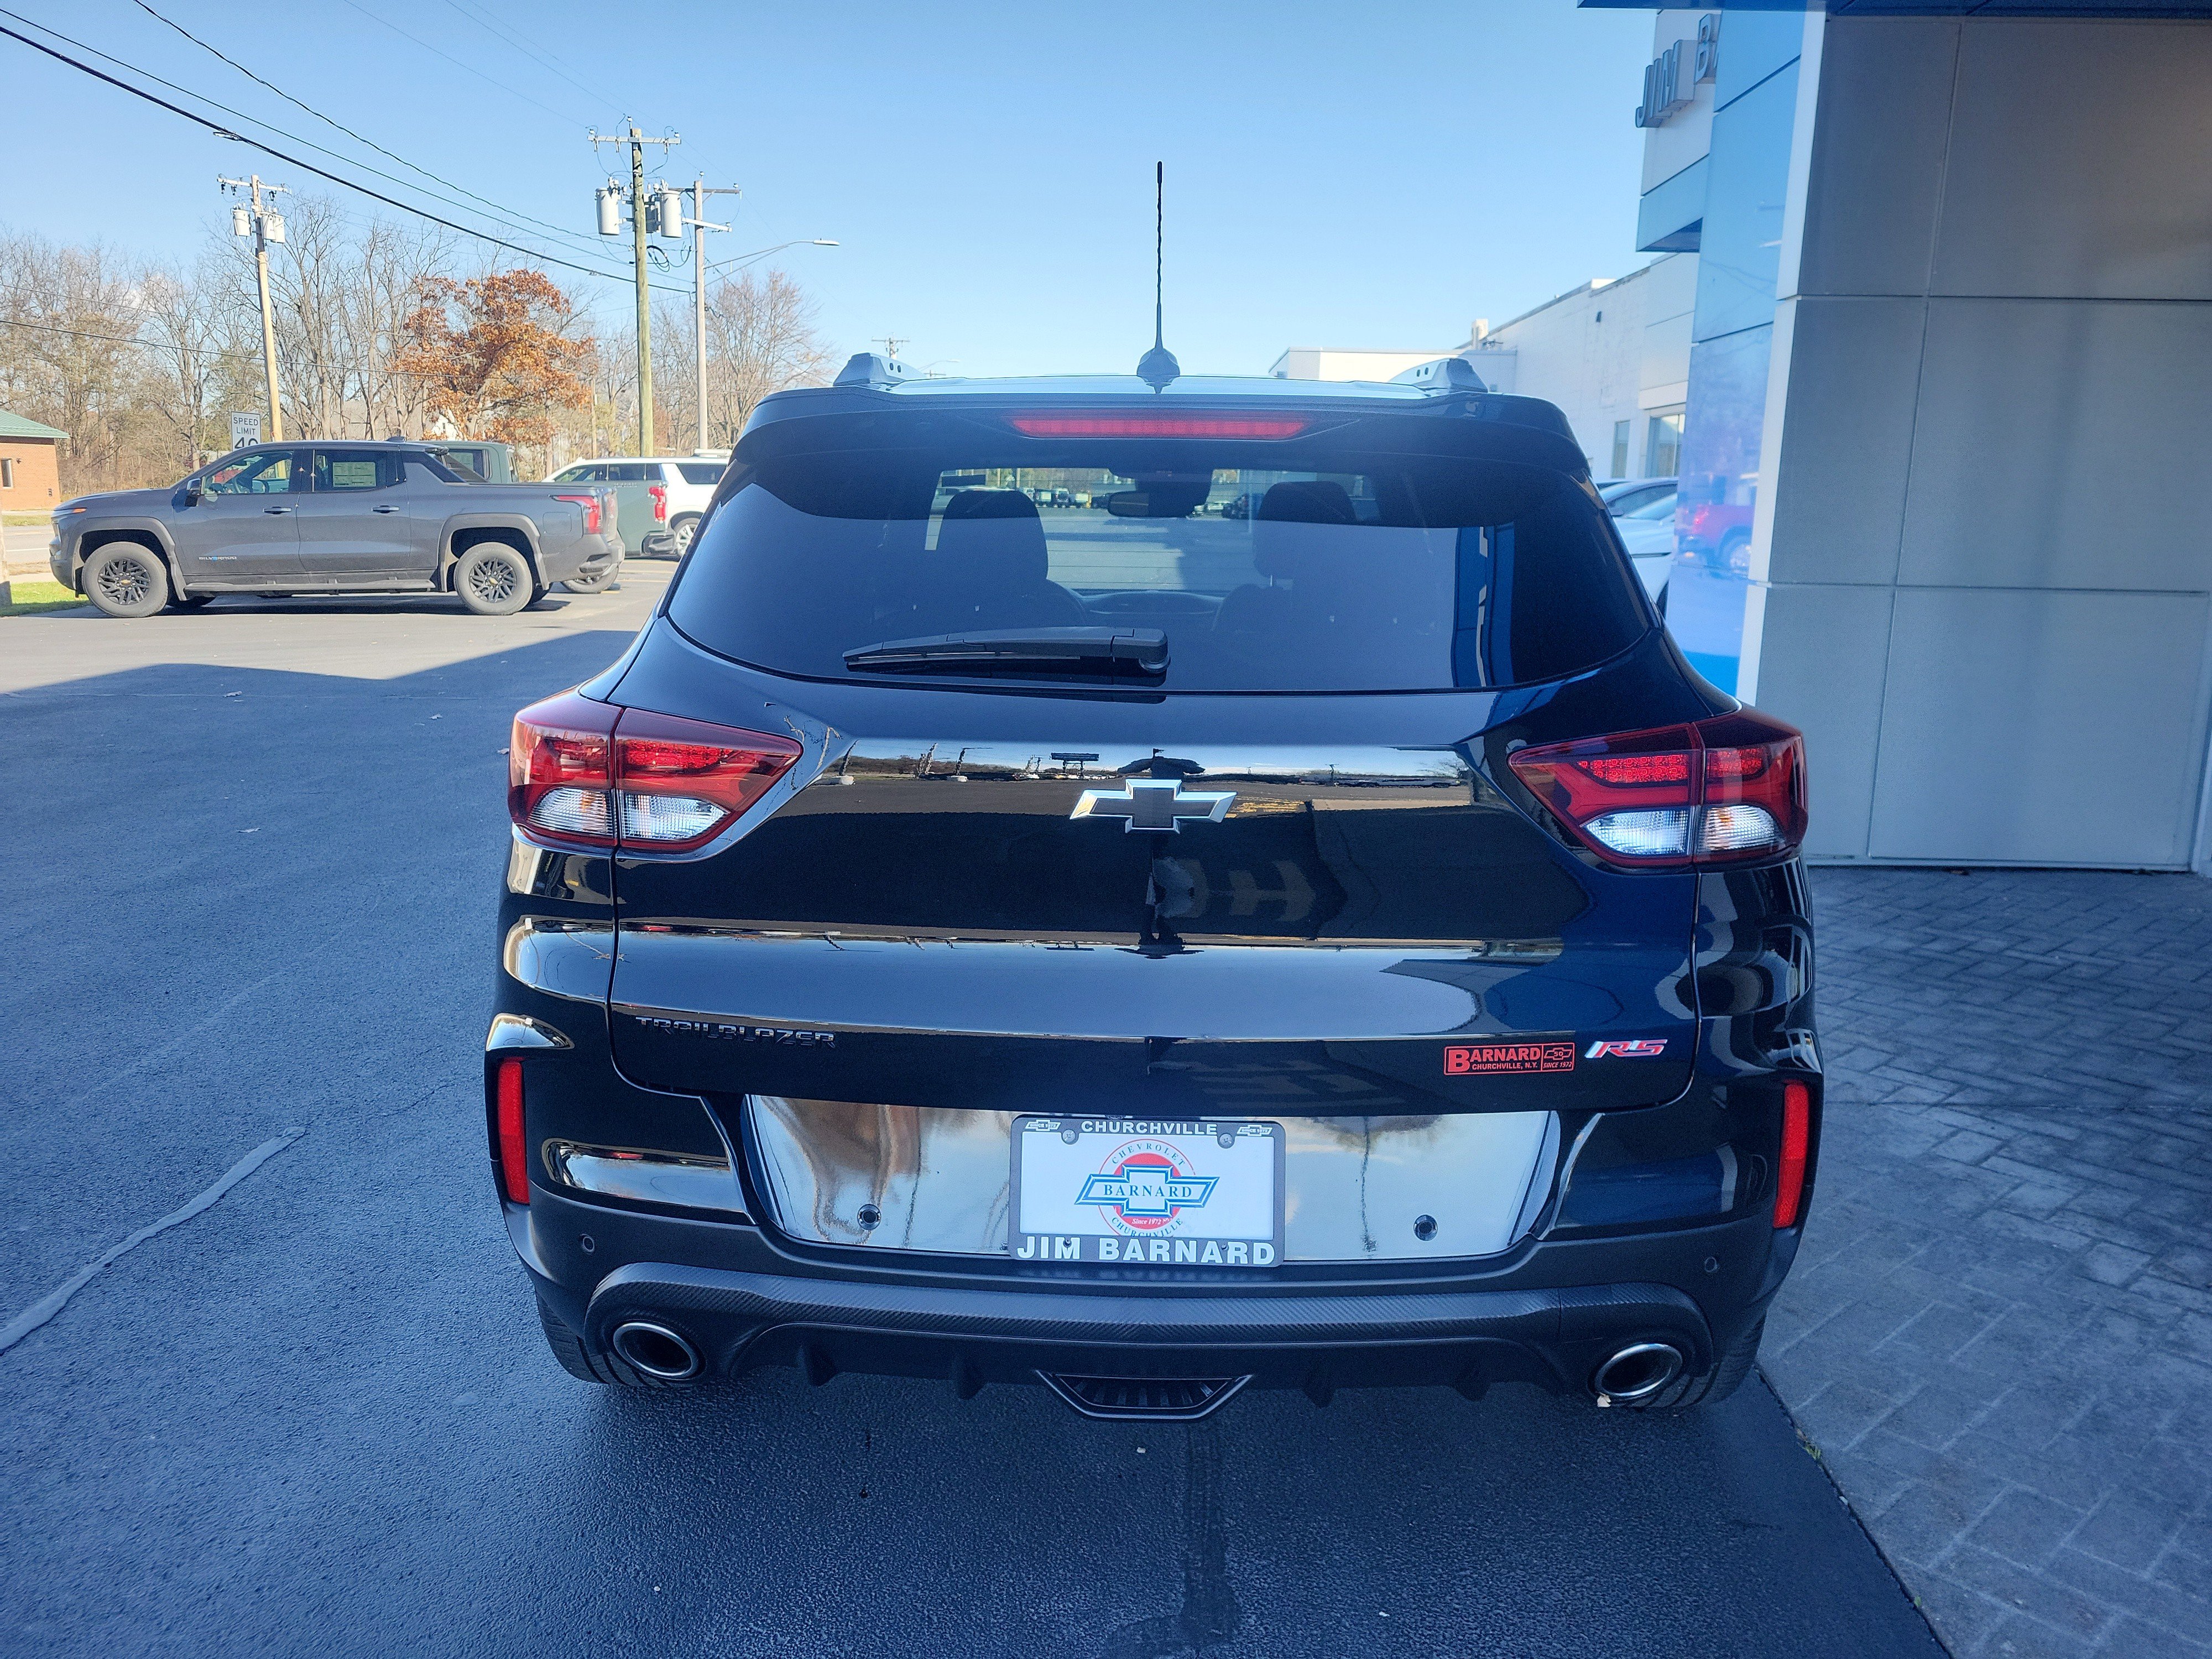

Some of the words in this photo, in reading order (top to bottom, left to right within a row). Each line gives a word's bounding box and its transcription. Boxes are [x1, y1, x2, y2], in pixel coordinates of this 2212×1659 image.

[1635, 39, 1694, 128] JIM
[233, 417, 258, 426] SPEED
[237, 427, 255, 435] LIMIT
[636, 1016, 836, 1048] TRAILBLAZER
[1603, 1040, 1667, 1057] RS
[1448, 1047, 1541, 1072] BARNARD
[1081, 1120, 1217, 1135] CHURCHVILLE
[1112, 1142, 1185, 1166] CHEVROLET
[1104, 1184, 1192, 1197] BARNARD
[1018, 1236, 1081, 1260] JIM
[1099, 1238, 1275, 1265] BARNARD
